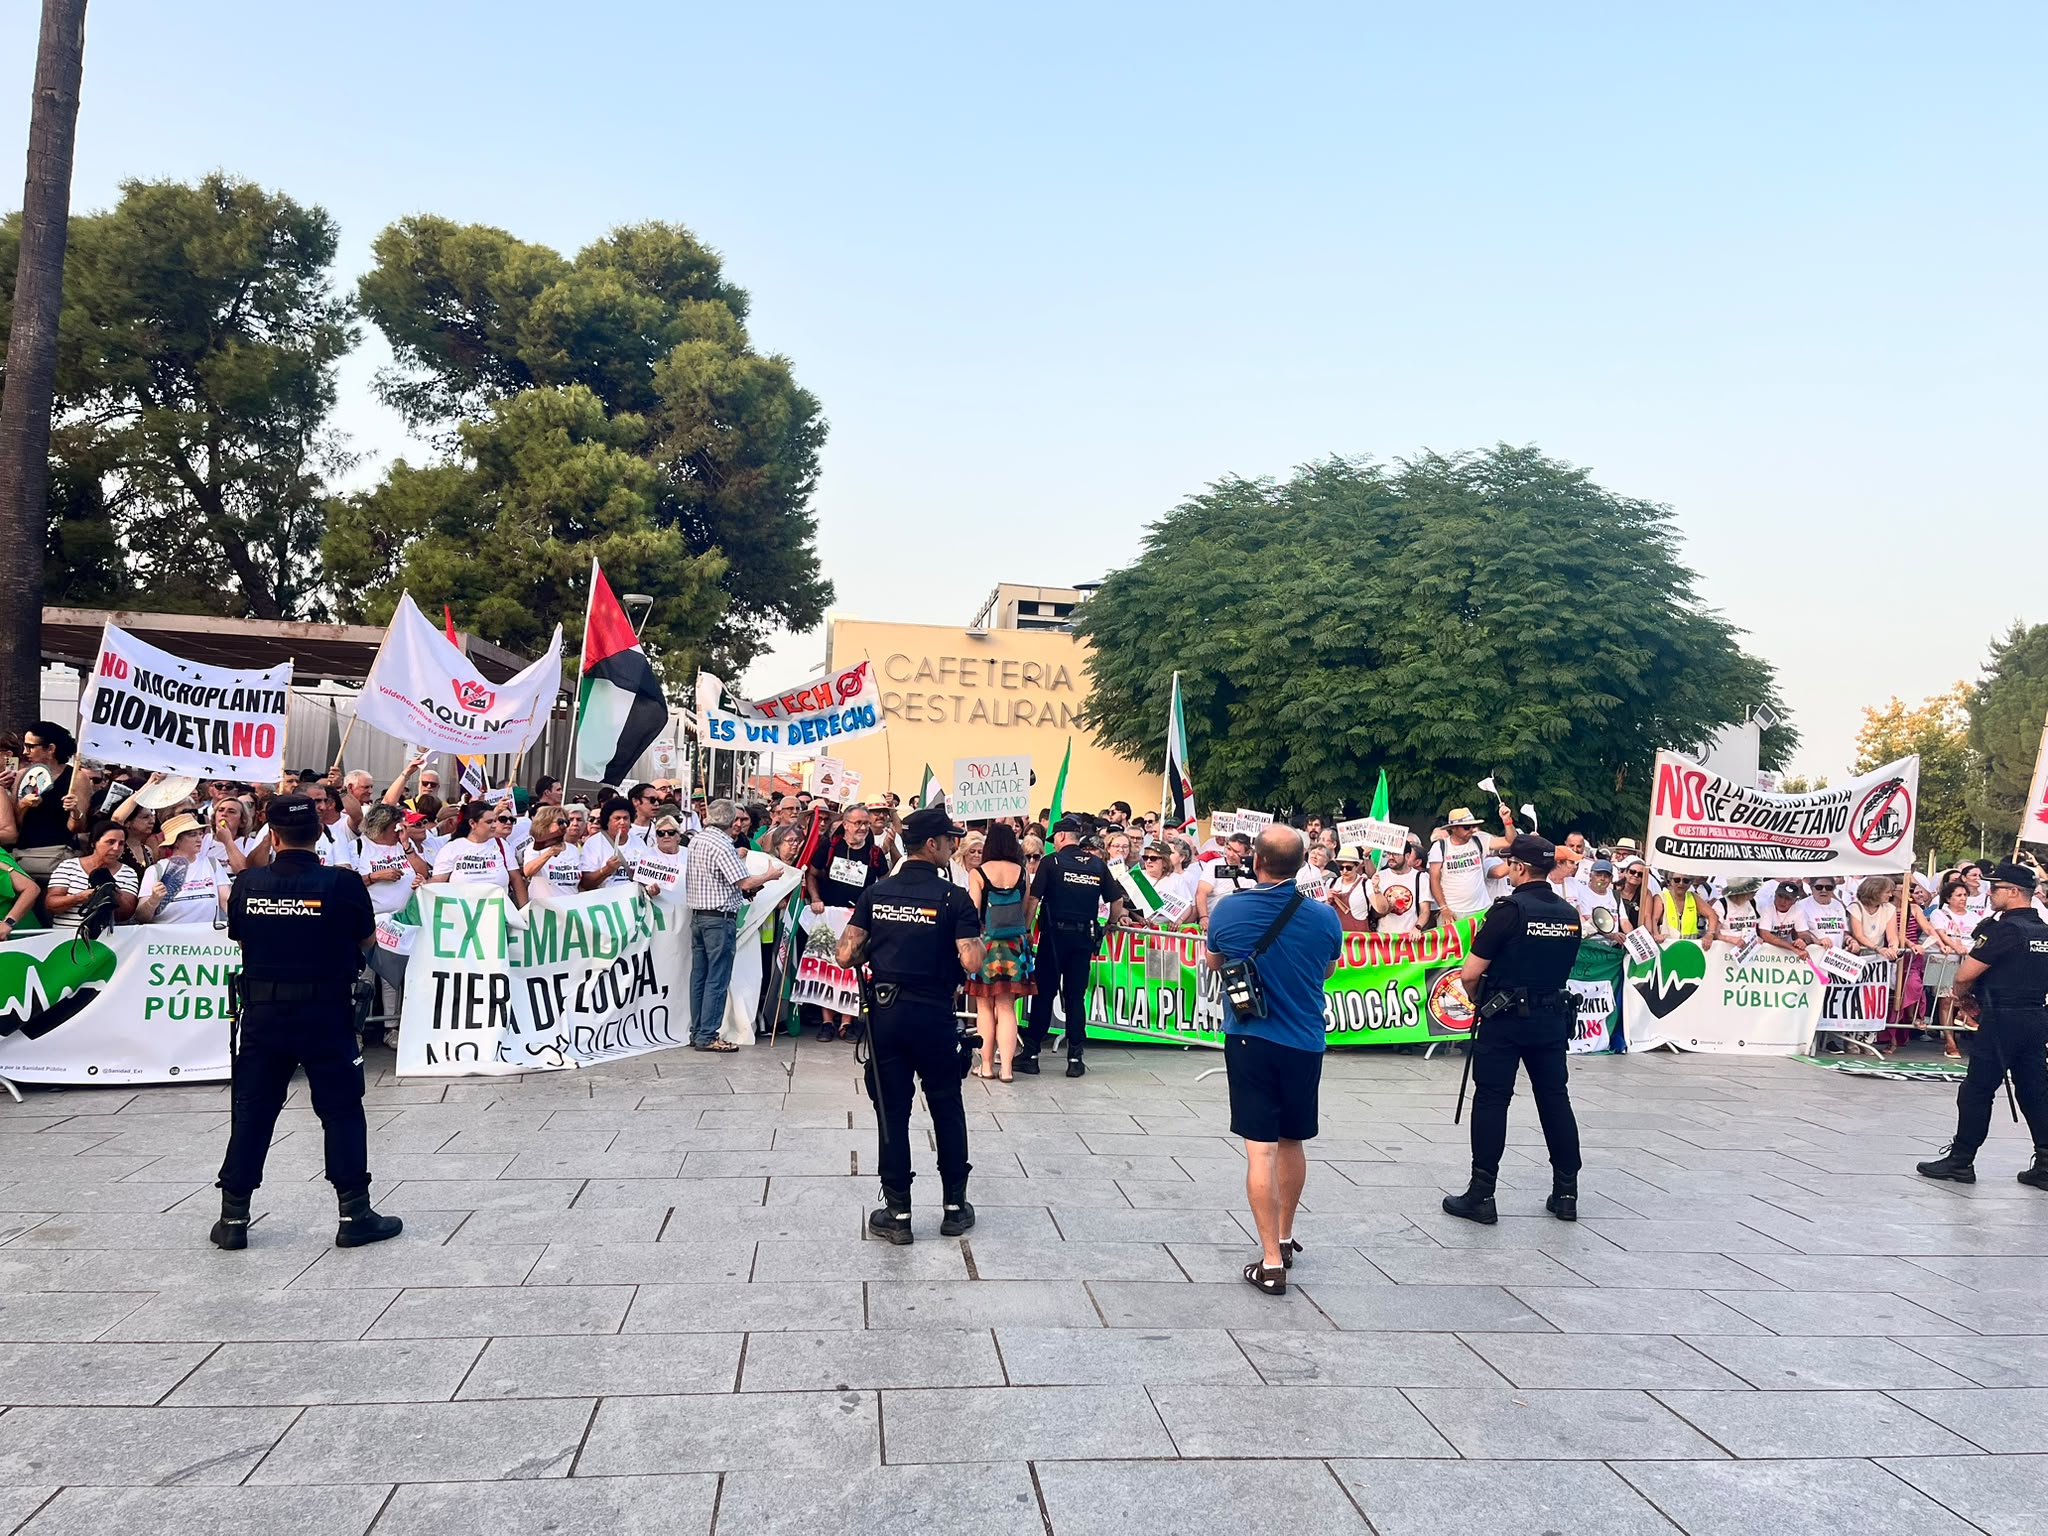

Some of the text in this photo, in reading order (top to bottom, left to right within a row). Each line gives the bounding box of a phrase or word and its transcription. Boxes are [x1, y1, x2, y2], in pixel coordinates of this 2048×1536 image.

[885, 653, 1073, 691] CAFETERIA
[100, 652, 286, 715] NO MACROPLANTA
[91, 687, 276, 758] BIOMETANO
[420, 697, 476, 730] AQUÍ
[709, 704, 877, 746] ES UN DERECHO
[968, 761, 1019, 778] NO A LA
[959, 778, 1024, 797] PLANTA DE
[1656, 763, 1706, 821] NO
[1723, 782, 1745, 801] LA
[957, 796, 1027, 814] BIOMETANO
[1703, 793, 1849, 836] DE BIOMETANO
[1665, 839, 1829, 861] PLATAFORMA DE SANTA AMALIA
[637, 866, 676, 884] BIOMETANO
[246, 898, 305, 907] POLICIA
[246, 906, 322, 916] NACIONAL
[872, 904, 924, 915] POLICIA
[872, 911, 936, 924] NACIONAL
[1527, 922, 1569, 931] POLICIA
[1527, 929, 1578, 938] NACIONAL
[1725, 966, 1814, 985] SANIDAD
[145, 989, 241, 1020] PÚBL
[1090, 985, 1109, 1025] A
[1115, 986, 1150, 1029] LA
[1322, 980, 1420, 1033] BIOGÁS
[1723, 985, 1809, 1009] PÚBLICA
